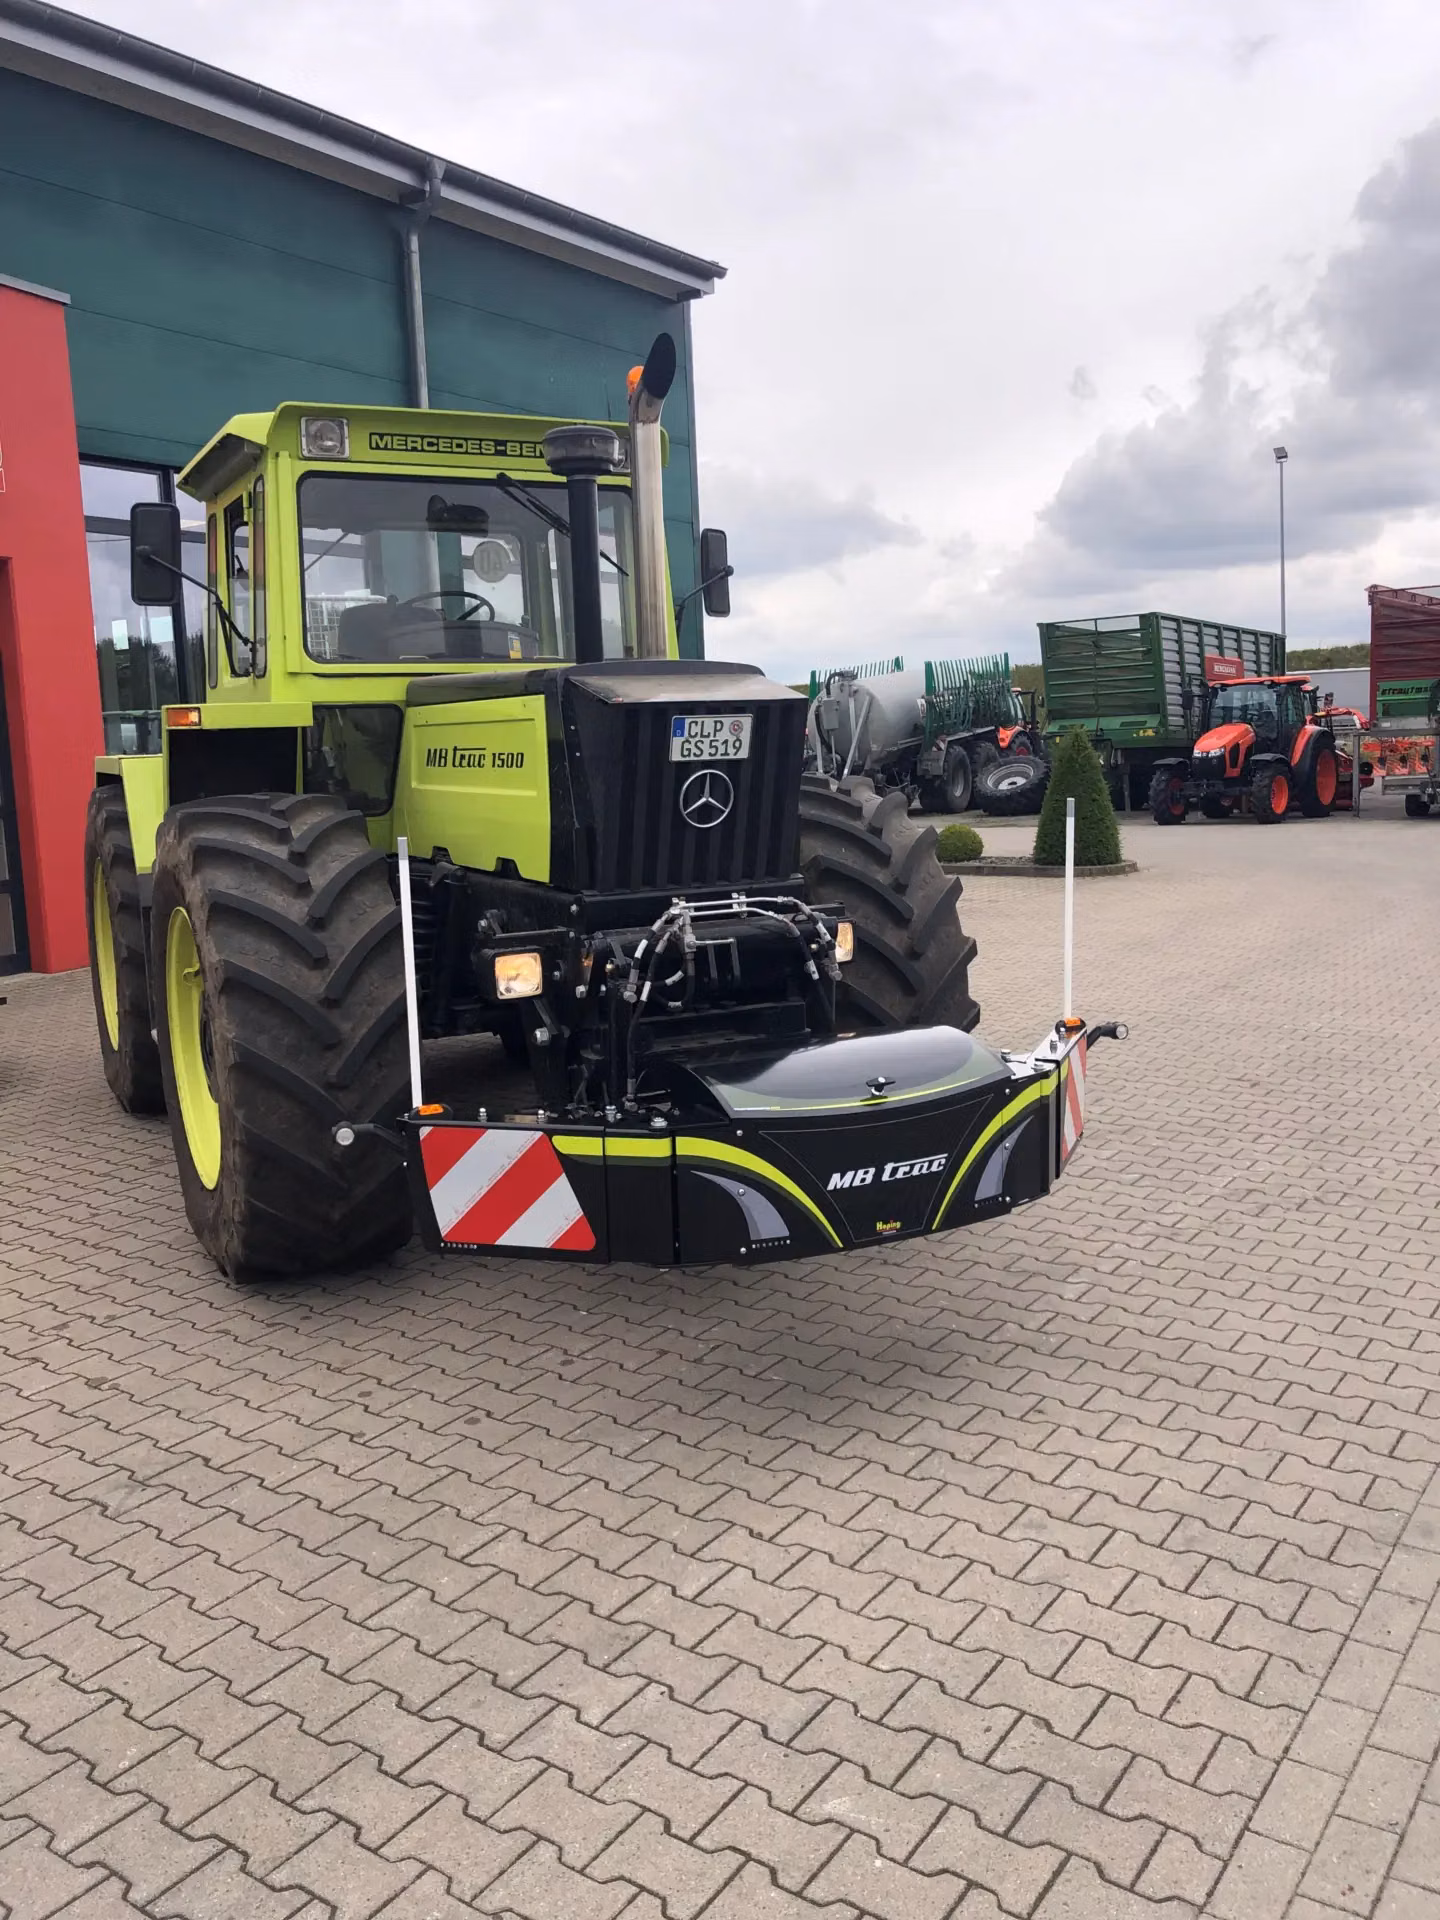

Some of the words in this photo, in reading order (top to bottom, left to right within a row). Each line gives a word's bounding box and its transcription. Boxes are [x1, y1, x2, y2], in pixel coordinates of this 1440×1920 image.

[370, 433, 545, 457] MERCEDES-BEN
[687, 719, 725, 739] CLP
[425, 747, 449, 768] MB
[452, 745, 487, 769] trac
[491, 751, 526, 769] 1500
[680, 739, 705, 758] GS
[708, 738, 743, 757] 519
[826, 1167, 876, 1191] MB
[881, 1153, 949, 1182] trac
